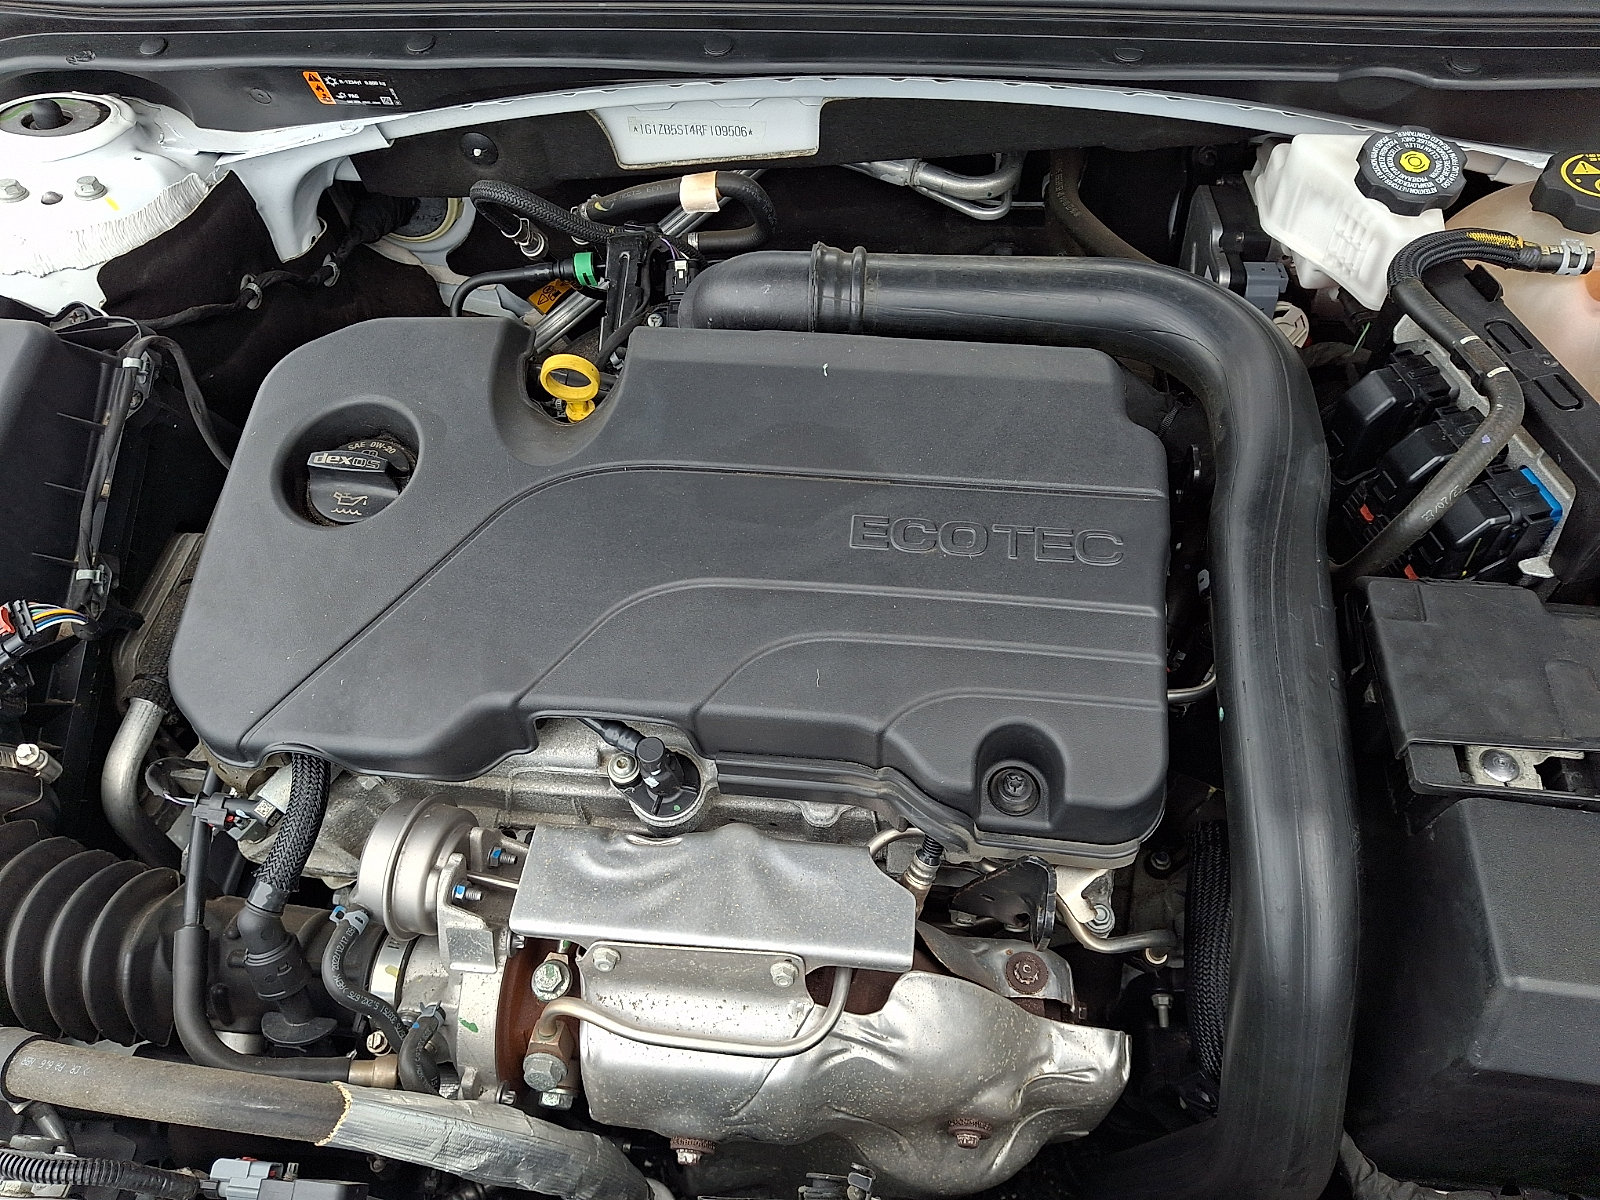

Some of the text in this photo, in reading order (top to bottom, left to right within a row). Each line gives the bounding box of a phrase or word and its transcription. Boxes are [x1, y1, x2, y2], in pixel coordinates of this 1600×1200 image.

[1429, 136, 1451, 150] SEALED
[1447, 152, 1459, 164] FROM
[1441, 159, 1451, 176] BEFORE
[1449, 165, 1459, 178] FLUID
[1439, 179, 1452, 188] DOT
[347, 441, 366, 451] SAE
[369, 441, 397, 454] 0W-20
[313, 452, 381, 470] dexos
[849, 514, 1124, 566] ECOTEC
